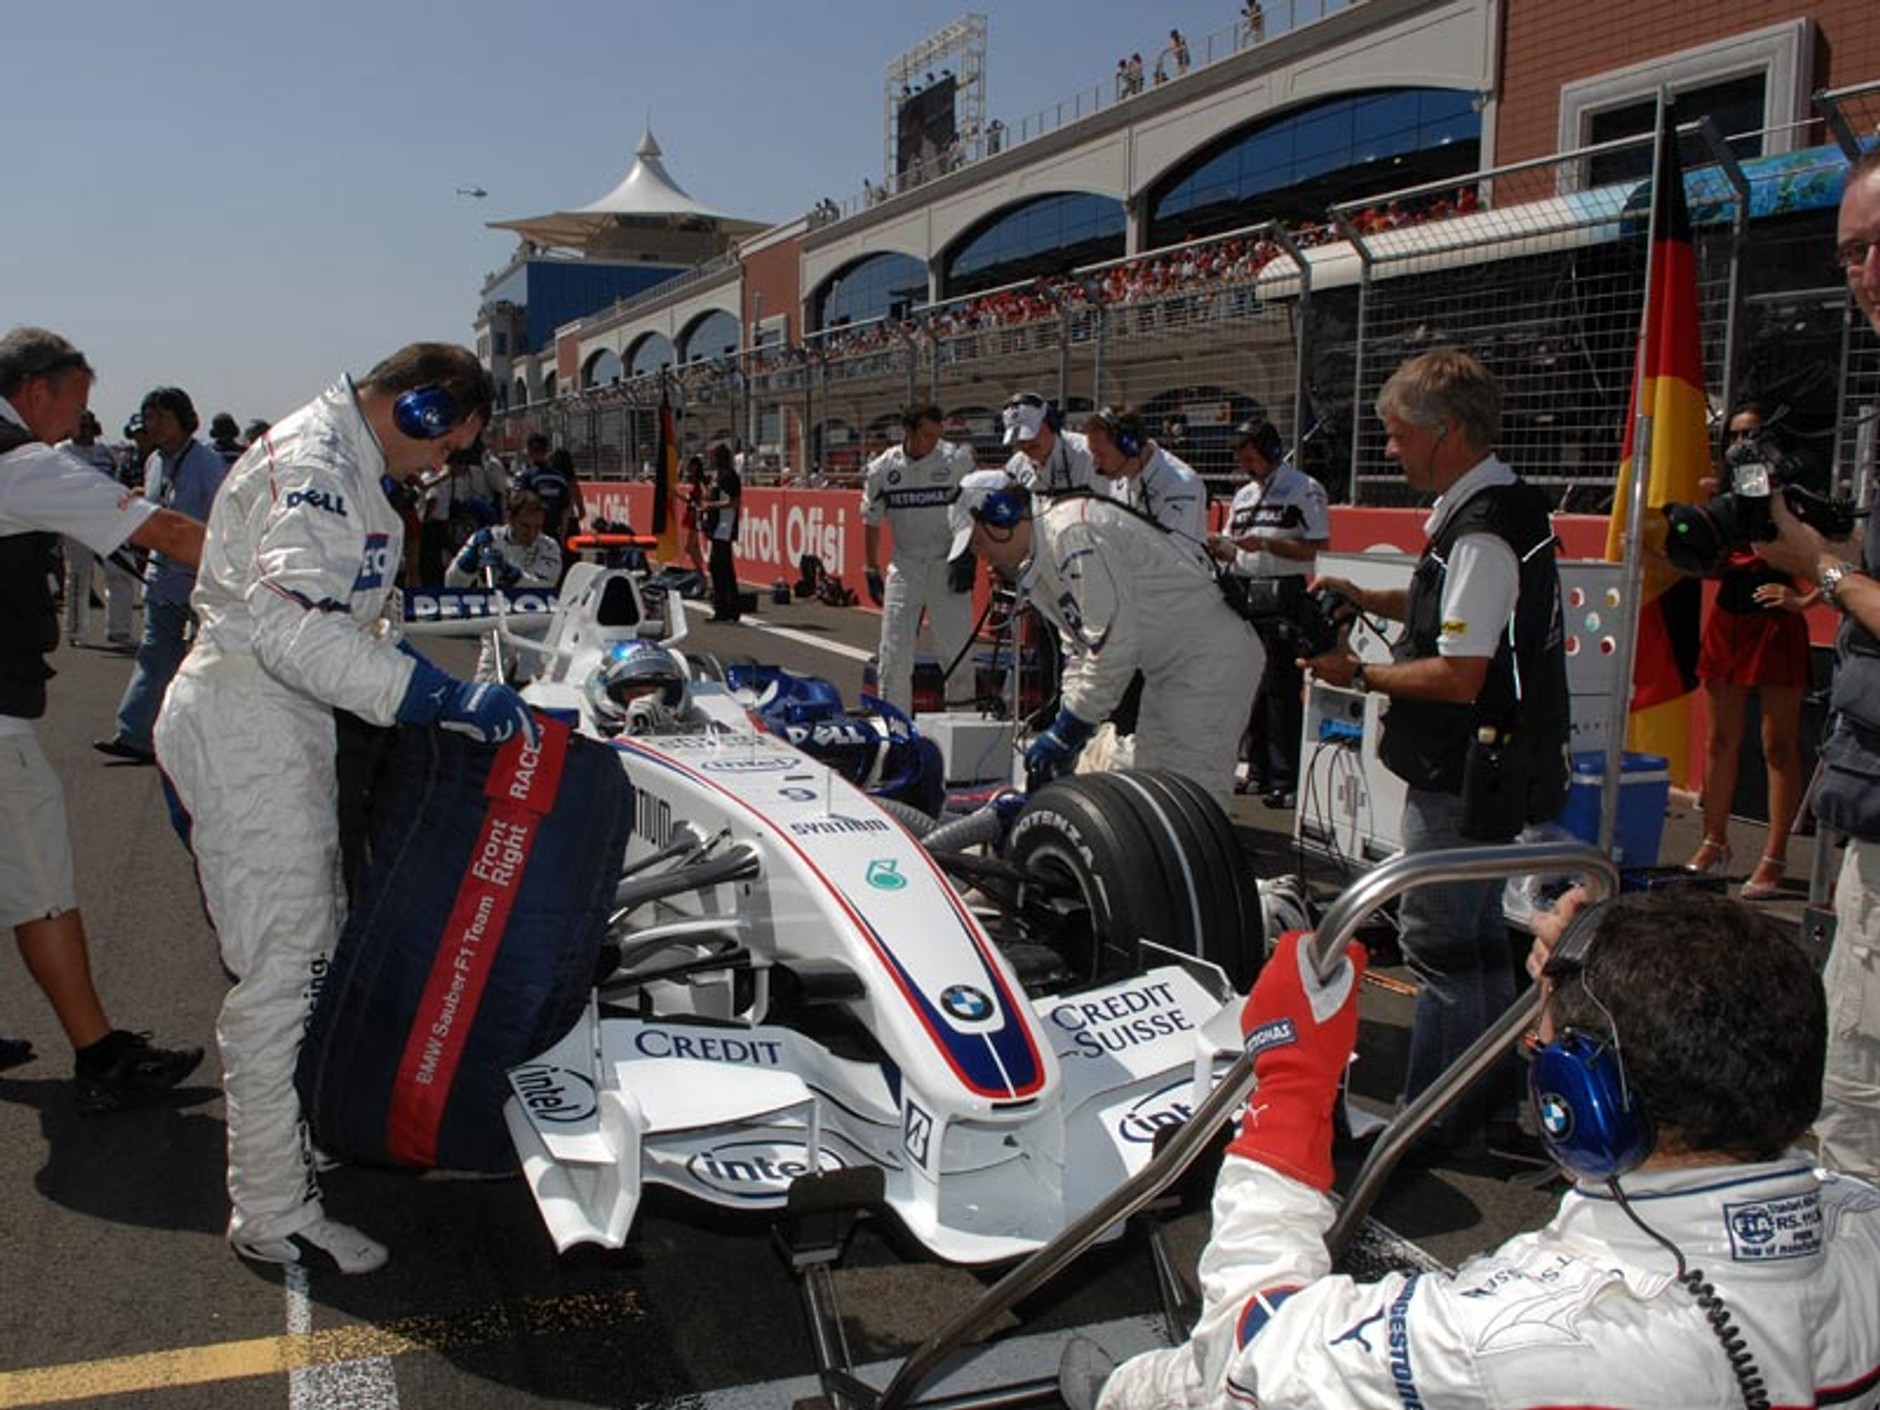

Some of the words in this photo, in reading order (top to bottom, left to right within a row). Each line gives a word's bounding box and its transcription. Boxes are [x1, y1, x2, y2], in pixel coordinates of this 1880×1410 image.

[286, 489, 348, 518] DELL
[786, 506, 843, 576] Ofisi
[413, 594, 559, 616] PETRO
[786, 724, 866, 746] DELL
[473, 819, 508, 880] Front
[491, 825, 528, 888] Right
[463, 895, 496, 943] Team
[453, 946, 476, 972] F1
[433, 973, 467, 1037] Sauber
[1051, 982, 1176, 1032] CREDIT
[634, 1029, 782, 1064] CREDIT
[1074, 1010, 1195, 1059] SUISSE
[416, 1036, 442, 1085] BMW
[516, 1066, 581, 1114] intel
[1126, 1102, 1193, 1132] int
[701, 1151, 808, 1182] inte
